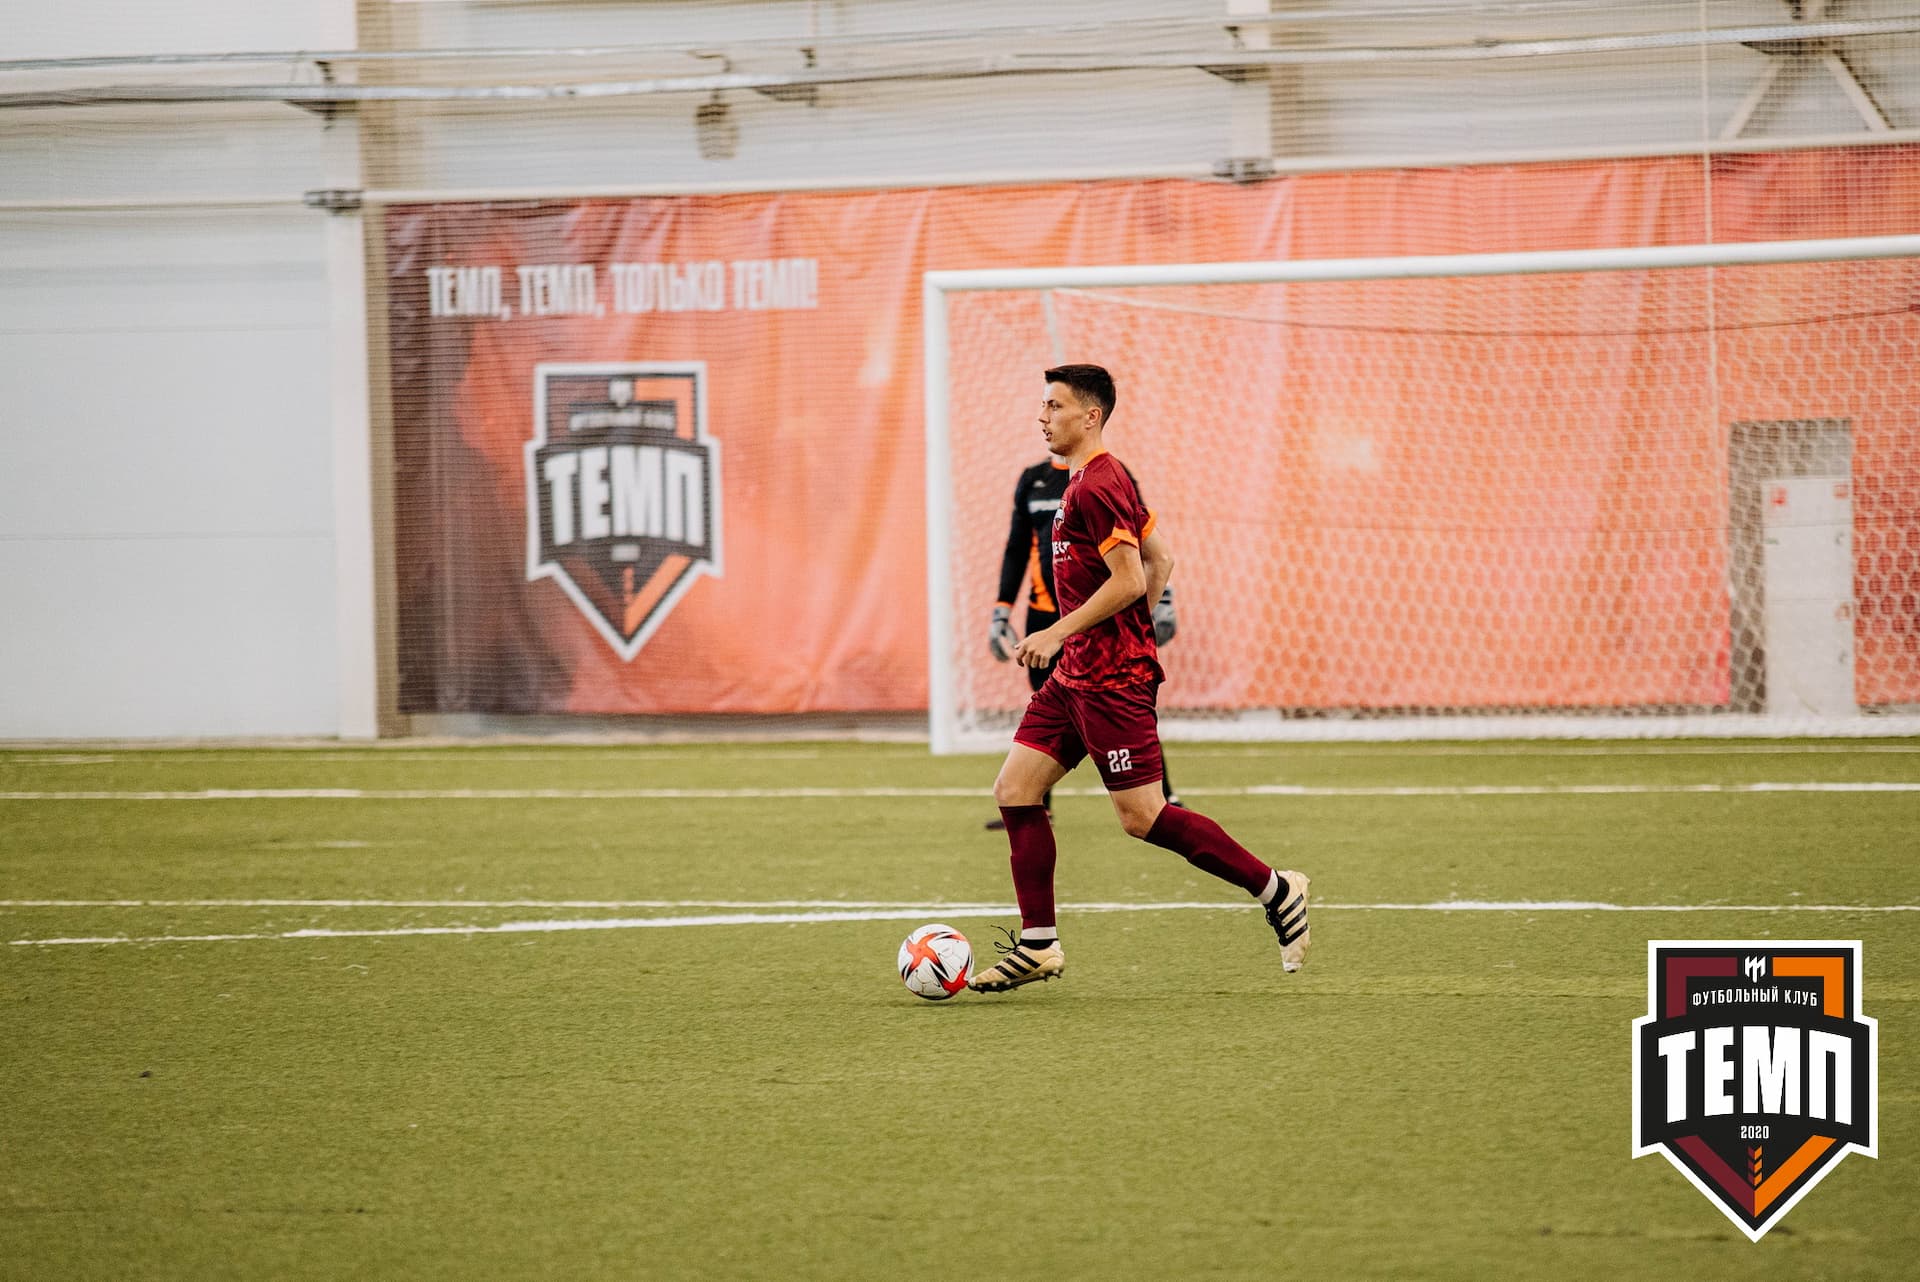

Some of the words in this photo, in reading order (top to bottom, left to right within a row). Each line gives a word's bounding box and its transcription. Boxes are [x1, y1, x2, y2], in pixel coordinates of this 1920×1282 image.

[427, 265, 512, 320] ТЕМП,
[516, 262, 605, 319] ТЕМП,
[609, 259, 725, 314] ТОЛЬКО
[730, 257, 819, 311] ТЕМП!
[543, 444, 704, 547] ТЕМП
[1107, 748, 1133, 773] 22
